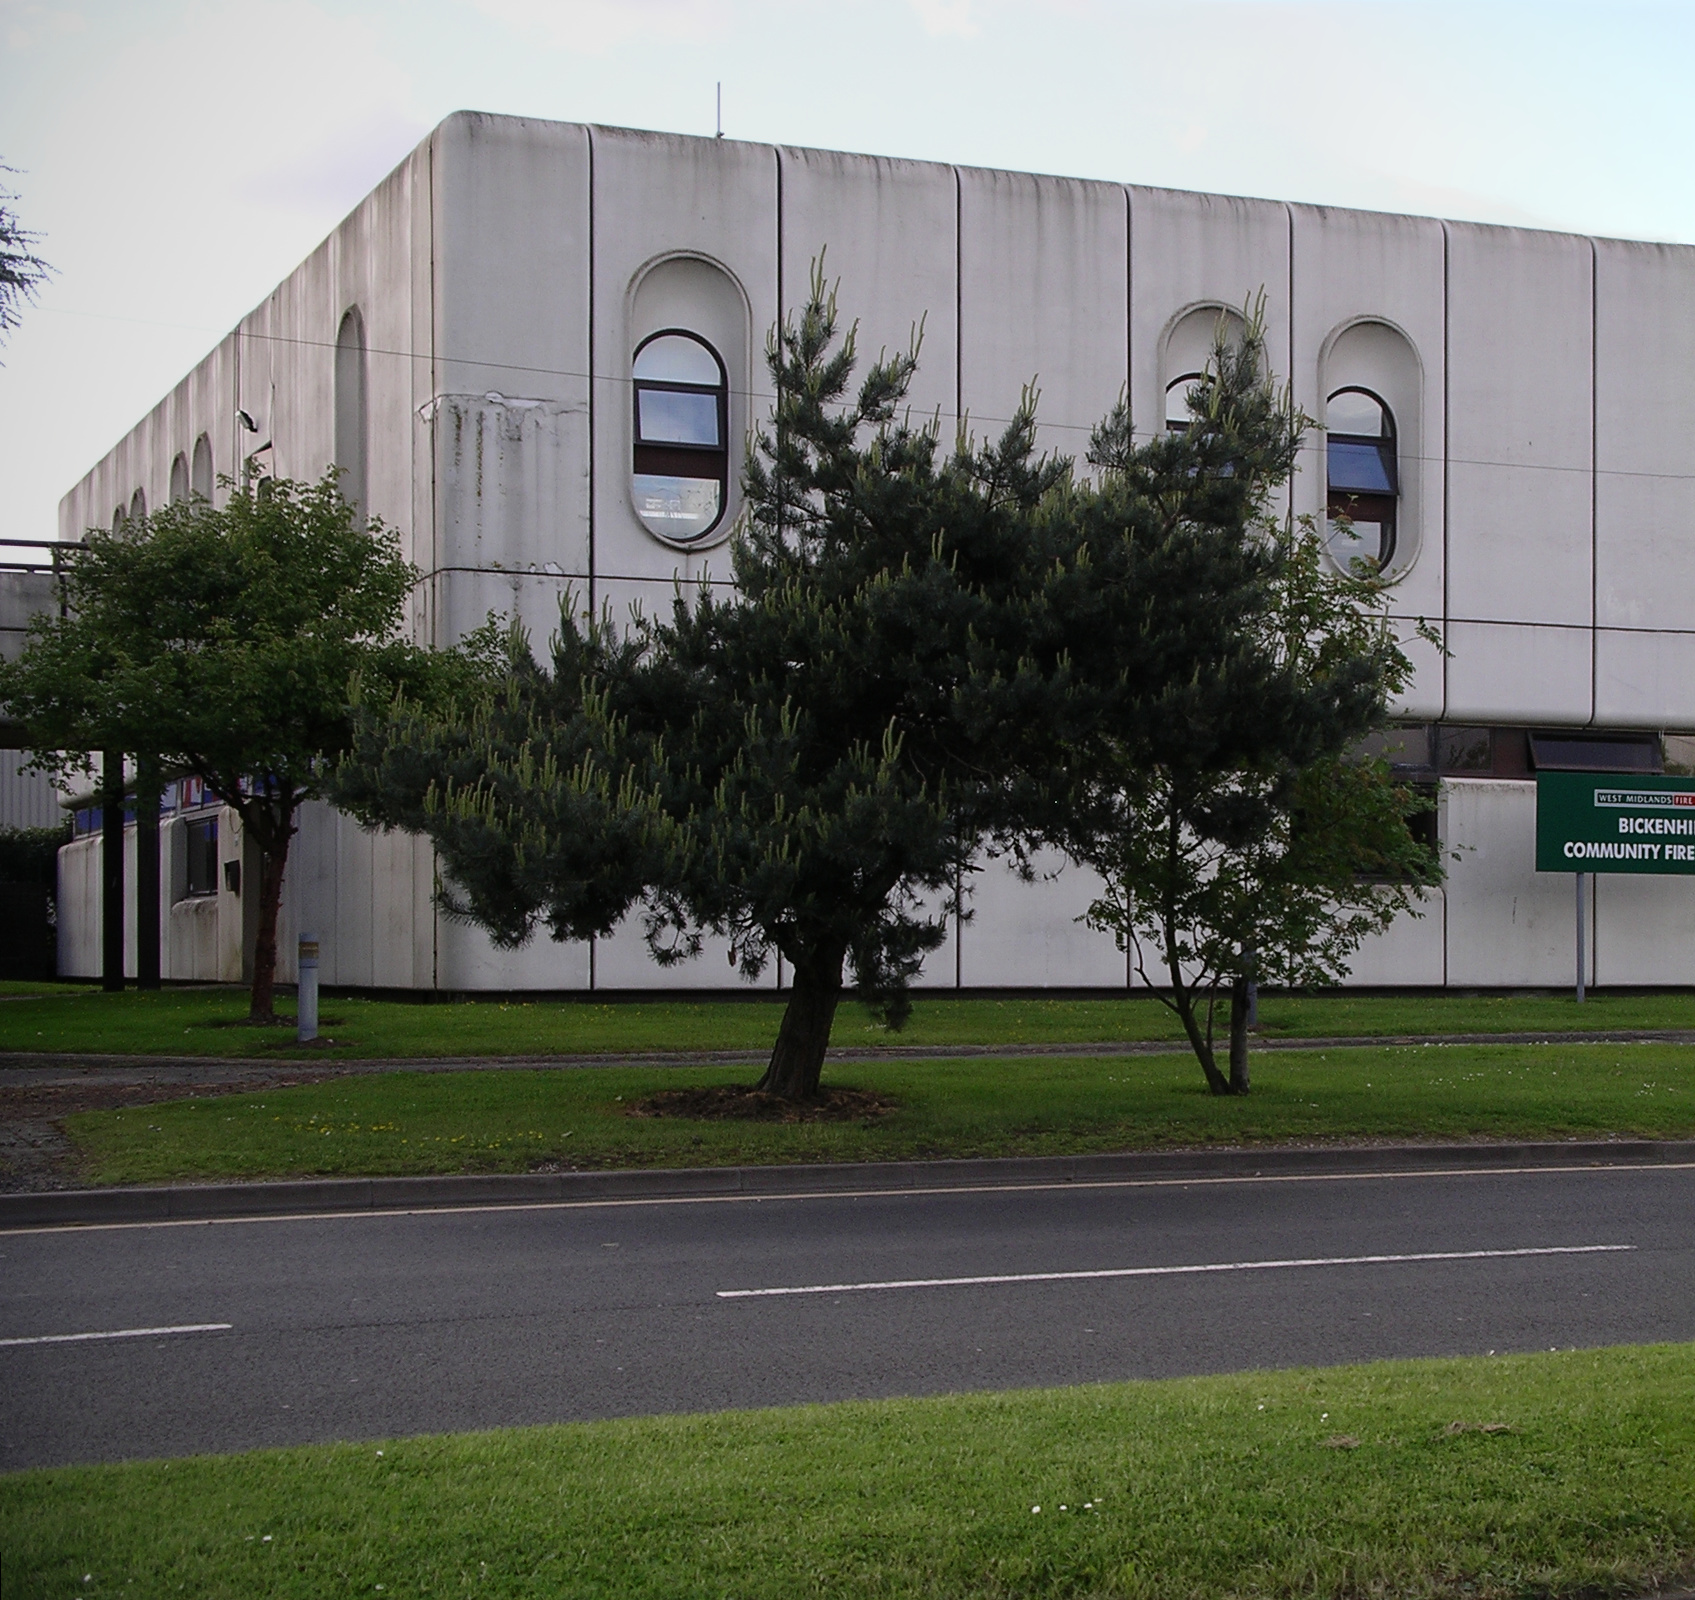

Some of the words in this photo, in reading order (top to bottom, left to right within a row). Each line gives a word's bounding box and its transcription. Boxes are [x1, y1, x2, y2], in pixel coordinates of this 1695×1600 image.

[1599, 794, 1622, 803] WEST
[1626, 795, 1672, 804] MIDLANDS
[1675, 796, 1693, 805] FIRE
[1564, 842, 1661, 860] COMMUNITY
[1664, 845, 1695, 861] FIRE
